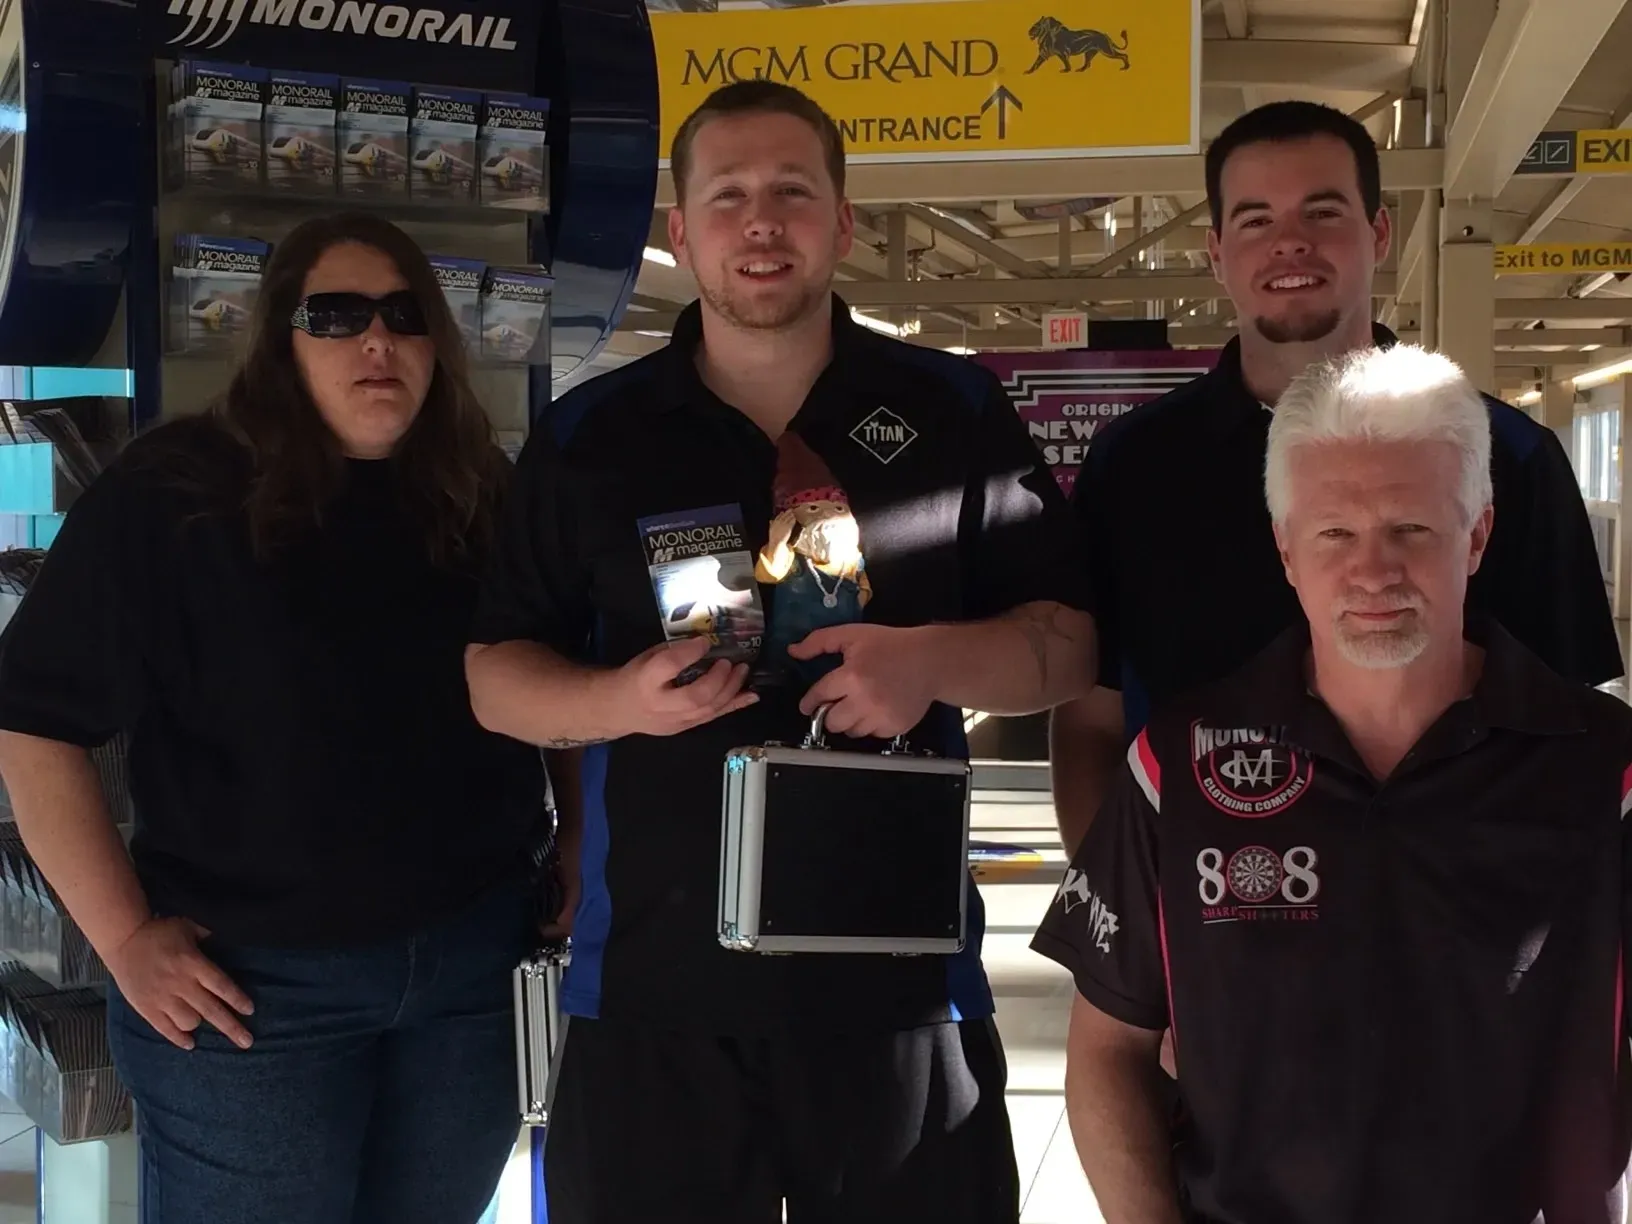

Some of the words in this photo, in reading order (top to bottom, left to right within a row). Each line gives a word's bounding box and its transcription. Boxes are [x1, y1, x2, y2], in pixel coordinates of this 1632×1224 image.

[249, 0, 517, 50] MONORAIL
[680, 45, 812, 85] MGM
[825, 39, 999, 83] GRAND
[196, 76, 260, 93] MONORAIL
[271, 84, 333, 99] MONORAIL
[213, 88, 260, 101] magazine
[346, 91, 407, 107] MONORAIL
[288, 97, 333, 109] magazine
[363, 102, 406, 115] magazine
[417, 99, 475, 115] MONORAIL
[433, 111, 476, 123] magazine
[488, 107, 544, 121] MONORAIL
[502, 118, 544, 130] magazine
[832, 115, 982, 143] NTRANCE
[198, 250, 260, 265] MONORAIL
[1494, 250, 1535, 268] Exit
[1542, 251, 1564, 267] to
[1572, 248, 1632, 266] MGM
[432, 268, 479, 282] ONORAIL
[491, 282, 545, 296] MONORAIL
[1049, 318, 1081, 344] EXIT
[863, 420, 905, 445] TITAN
[1028, 420, 1098, 440] NEW
[648, 524, 741, 549] MONORAIL
[677, 537, 744, 556] magazine
[750, 636, 762, 648] 10
[1203, 776, 1253, 813] CLOTHING
[1255, 775, 1306, 812] COMPANY
